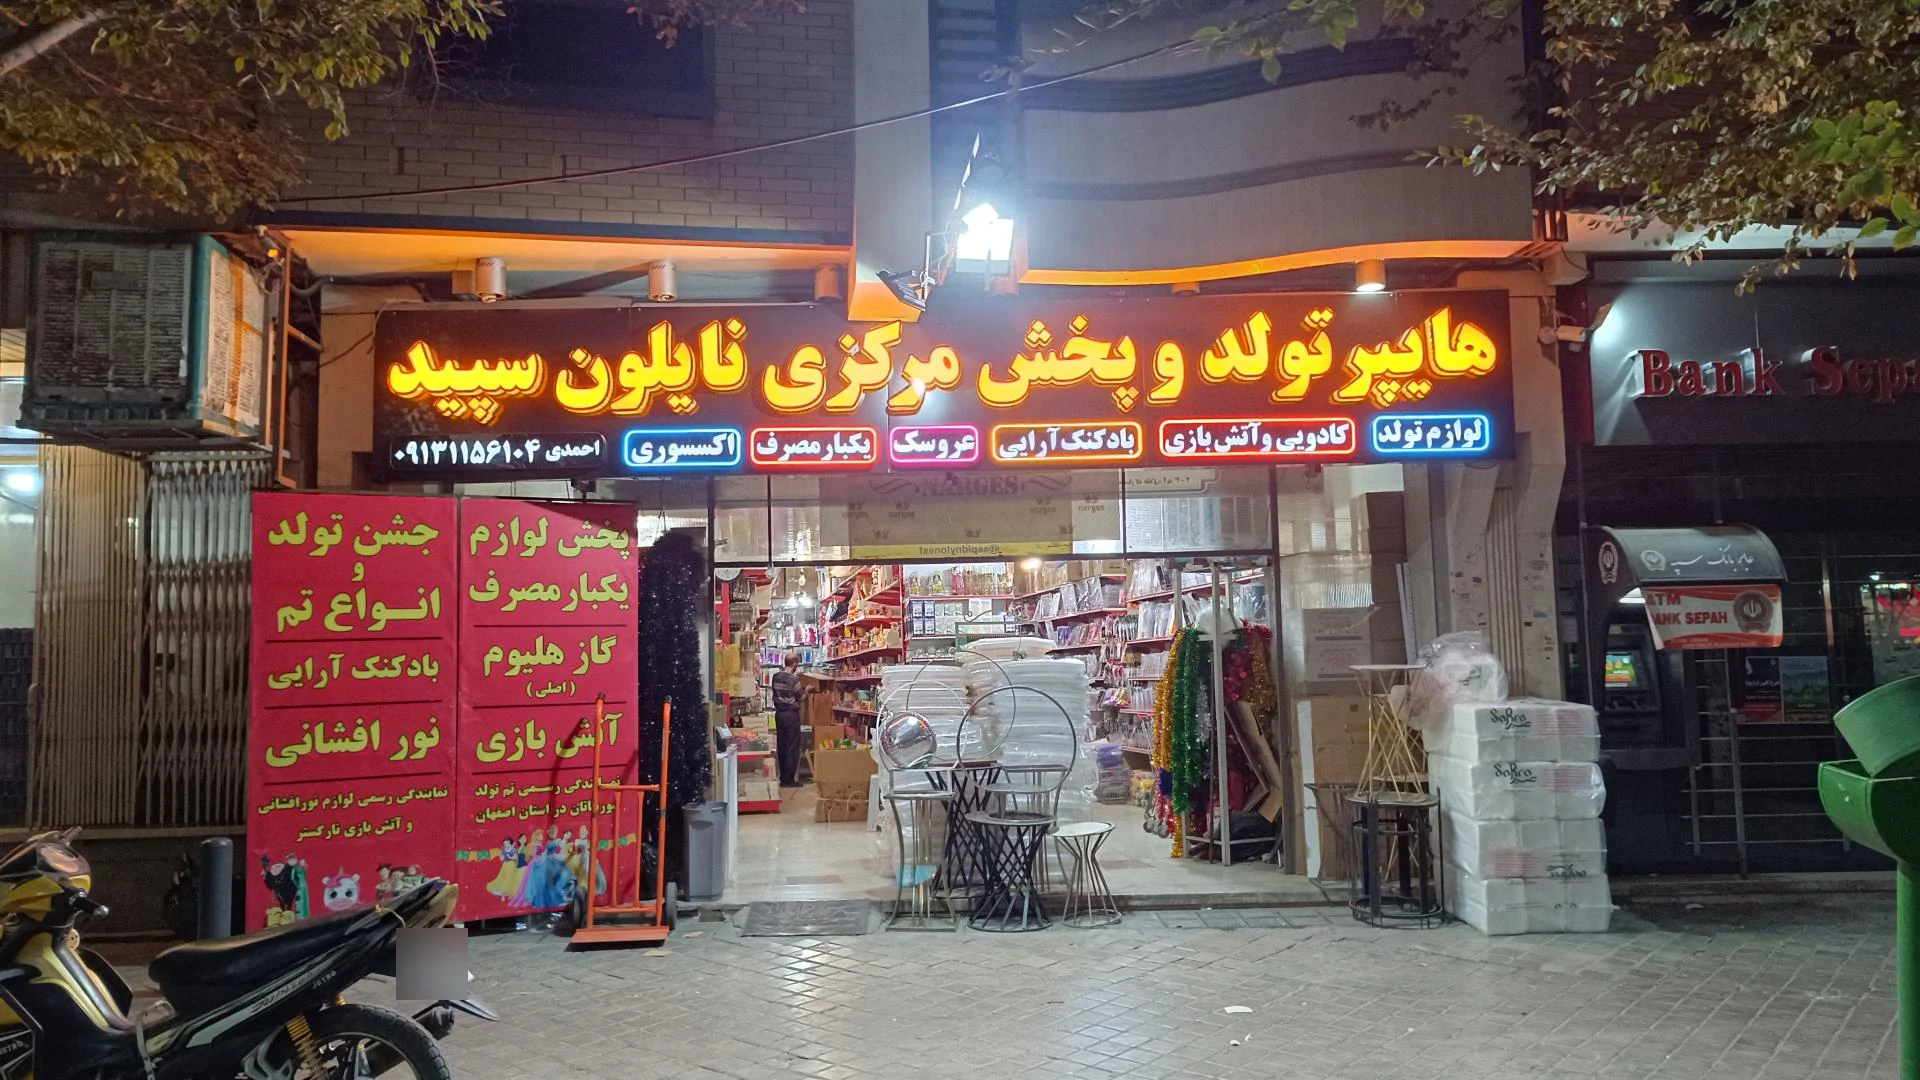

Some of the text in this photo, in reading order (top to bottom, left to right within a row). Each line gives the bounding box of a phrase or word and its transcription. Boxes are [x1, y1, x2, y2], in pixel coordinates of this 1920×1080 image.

[387, 305, 1498, 426] هایپر تولد و پخش مرکزی نایلون سپید
[1634, 347, 1786, 397] Bank
[631, 431, 735, 465] اکسسوری
[893, 429, 976, 460] عروسک
[999, 426, 1136, 459] بادکنک آرایی
[1164, 420, 1350, 454] کادویی و آتش بازی
[1378, 418, 1483, 450] لوازم تولد
[394, 438, 600, 465] احمدی ۰۹۱۳۱۱۵۶۱۰۴
[267, 511, 441, 557] جشن تولد
[469, 515, 632, 562] پخش لوازم
[350, 560, 366, 582] و
[1707, 544, 1736, 572] بانک
[277, 588, 315, 633] تم
[1646, 592, 1682, 606] ATM
[1685, 611, 1729, 625] SEPAH
[483, 633, 618, 678] گاز هلیوم
[266, 652, 440, 691] بادکنک آرایی
[264, 715, 441, 769] نور افشانی
[474, 710, 624, 764] آش بازی
[322, 791, 355, 811] لوازم
[357, 794, 393, 808] رسمی
[396, 785, 449, 805] نمایندگی
[474, 775, 622, 799] نماندگی رسمی تم تولد
[475, 805, 516, 824] اصفهان
[518, 803, 550, 820] استان
[553, 803, 568, 818] در
[343, 820, 372, 839] بازی
[374, 816, 403, 836] آتش
